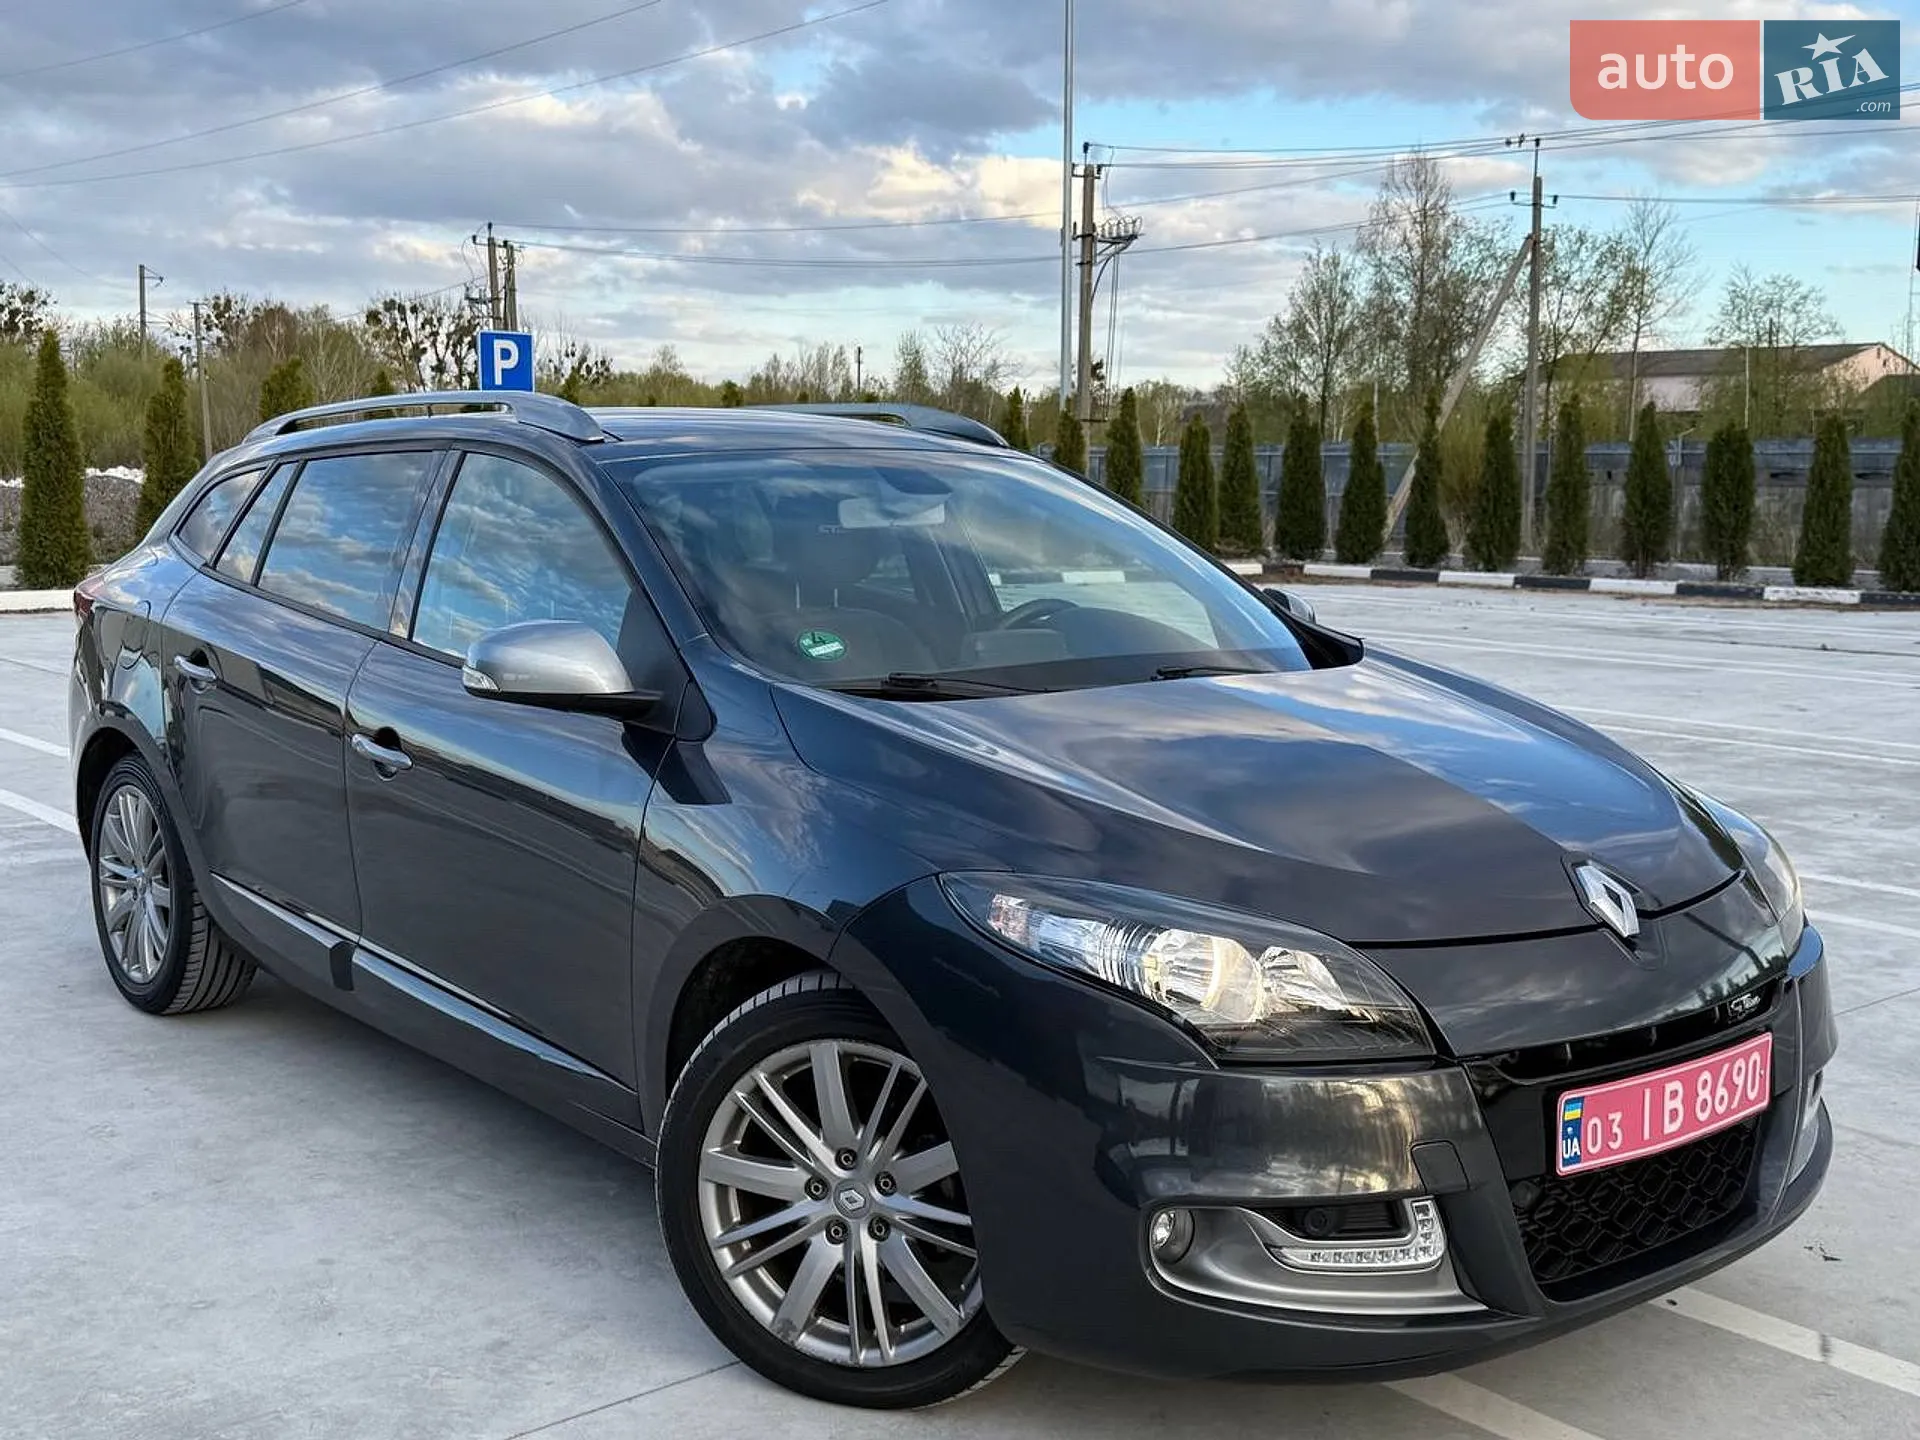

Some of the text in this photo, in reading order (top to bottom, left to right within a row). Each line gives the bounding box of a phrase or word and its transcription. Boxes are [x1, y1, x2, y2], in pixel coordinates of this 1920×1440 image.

[493, 338, 519, 385] P
[1586, 1051, 1762, 1155] 03 IB 8690
[1562, 1137, 1581, 1158] UA
